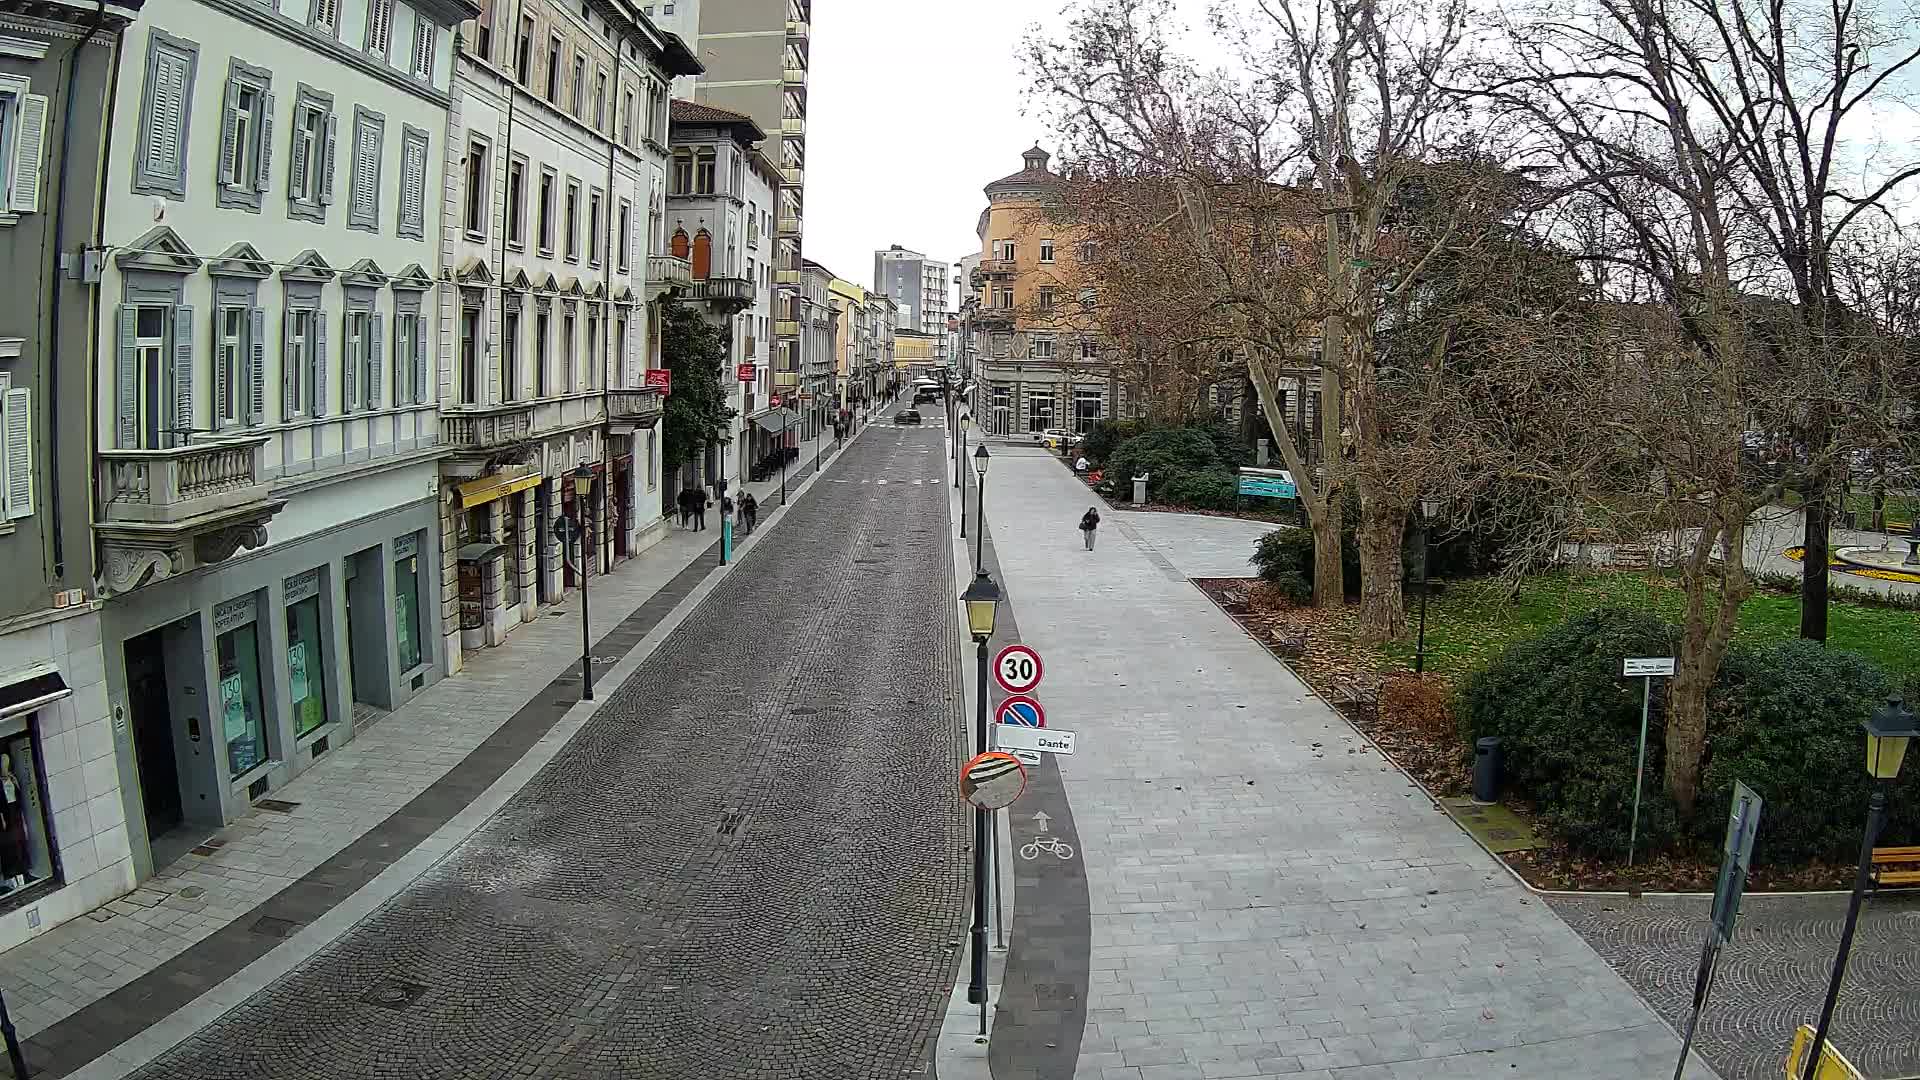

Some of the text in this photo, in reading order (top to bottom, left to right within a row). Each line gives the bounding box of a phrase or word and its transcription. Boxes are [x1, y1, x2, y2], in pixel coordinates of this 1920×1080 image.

[288, 644, 304, 664] 130
[1005, 658, 1033, 680] 30
[221, 677, 240, 700] 130
[1038, 738, 1069, 749] Dante
